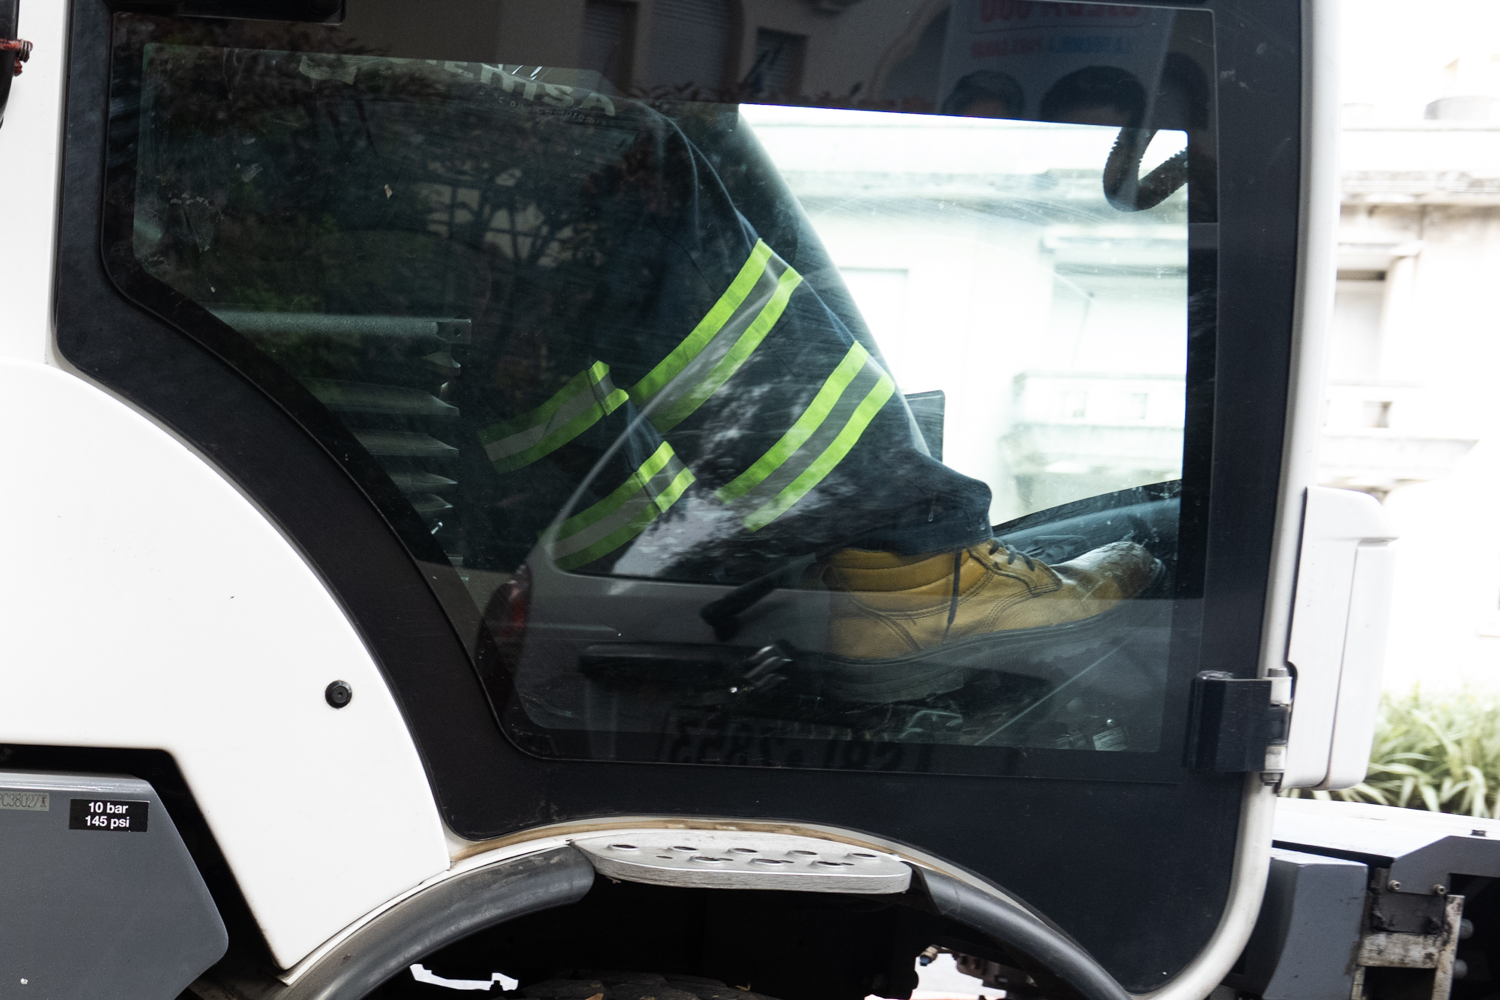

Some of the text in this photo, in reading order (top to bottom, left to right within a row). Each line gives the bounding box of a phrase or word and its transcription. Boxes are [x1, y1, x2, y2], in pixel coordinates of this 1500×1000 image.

[88, 801, 129, 814] 10 bar
[85, 815, 130, 829] 145 psi
